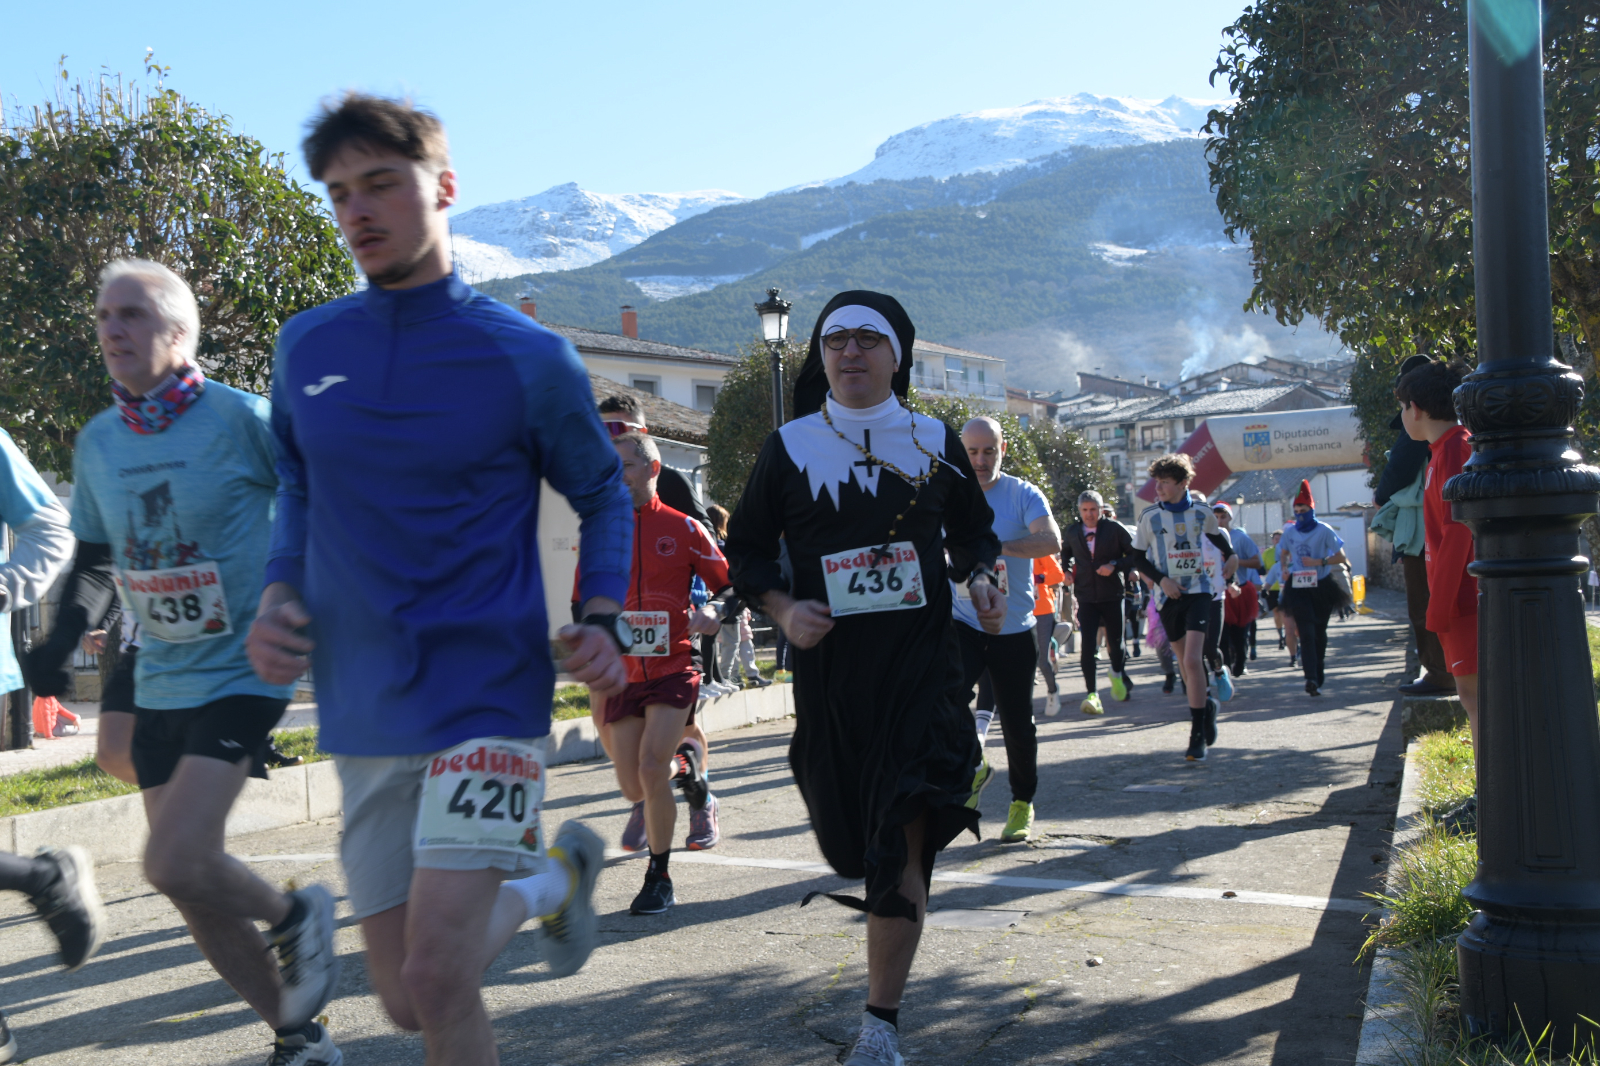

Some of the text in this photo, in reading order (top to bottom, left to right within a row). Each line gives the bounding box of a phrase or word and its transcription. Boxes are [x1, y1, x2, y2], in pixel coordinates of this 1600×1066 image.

[1273, 426, 1329, 441] Diputación
[1192, 441, 1214, 464] ORTE
[1287, 440, 1342, 453] Salamanca
[1176, 558, 1196, 569] 462
[848, 566, 903, 595] 436
[147, 593, 203, 624] 438
[626, 614, 668, 626] dunia
[632, 627, 656, 645] 30
[429, 746, 541, 782] bedunia
[447, 778, 526, 823] 420
